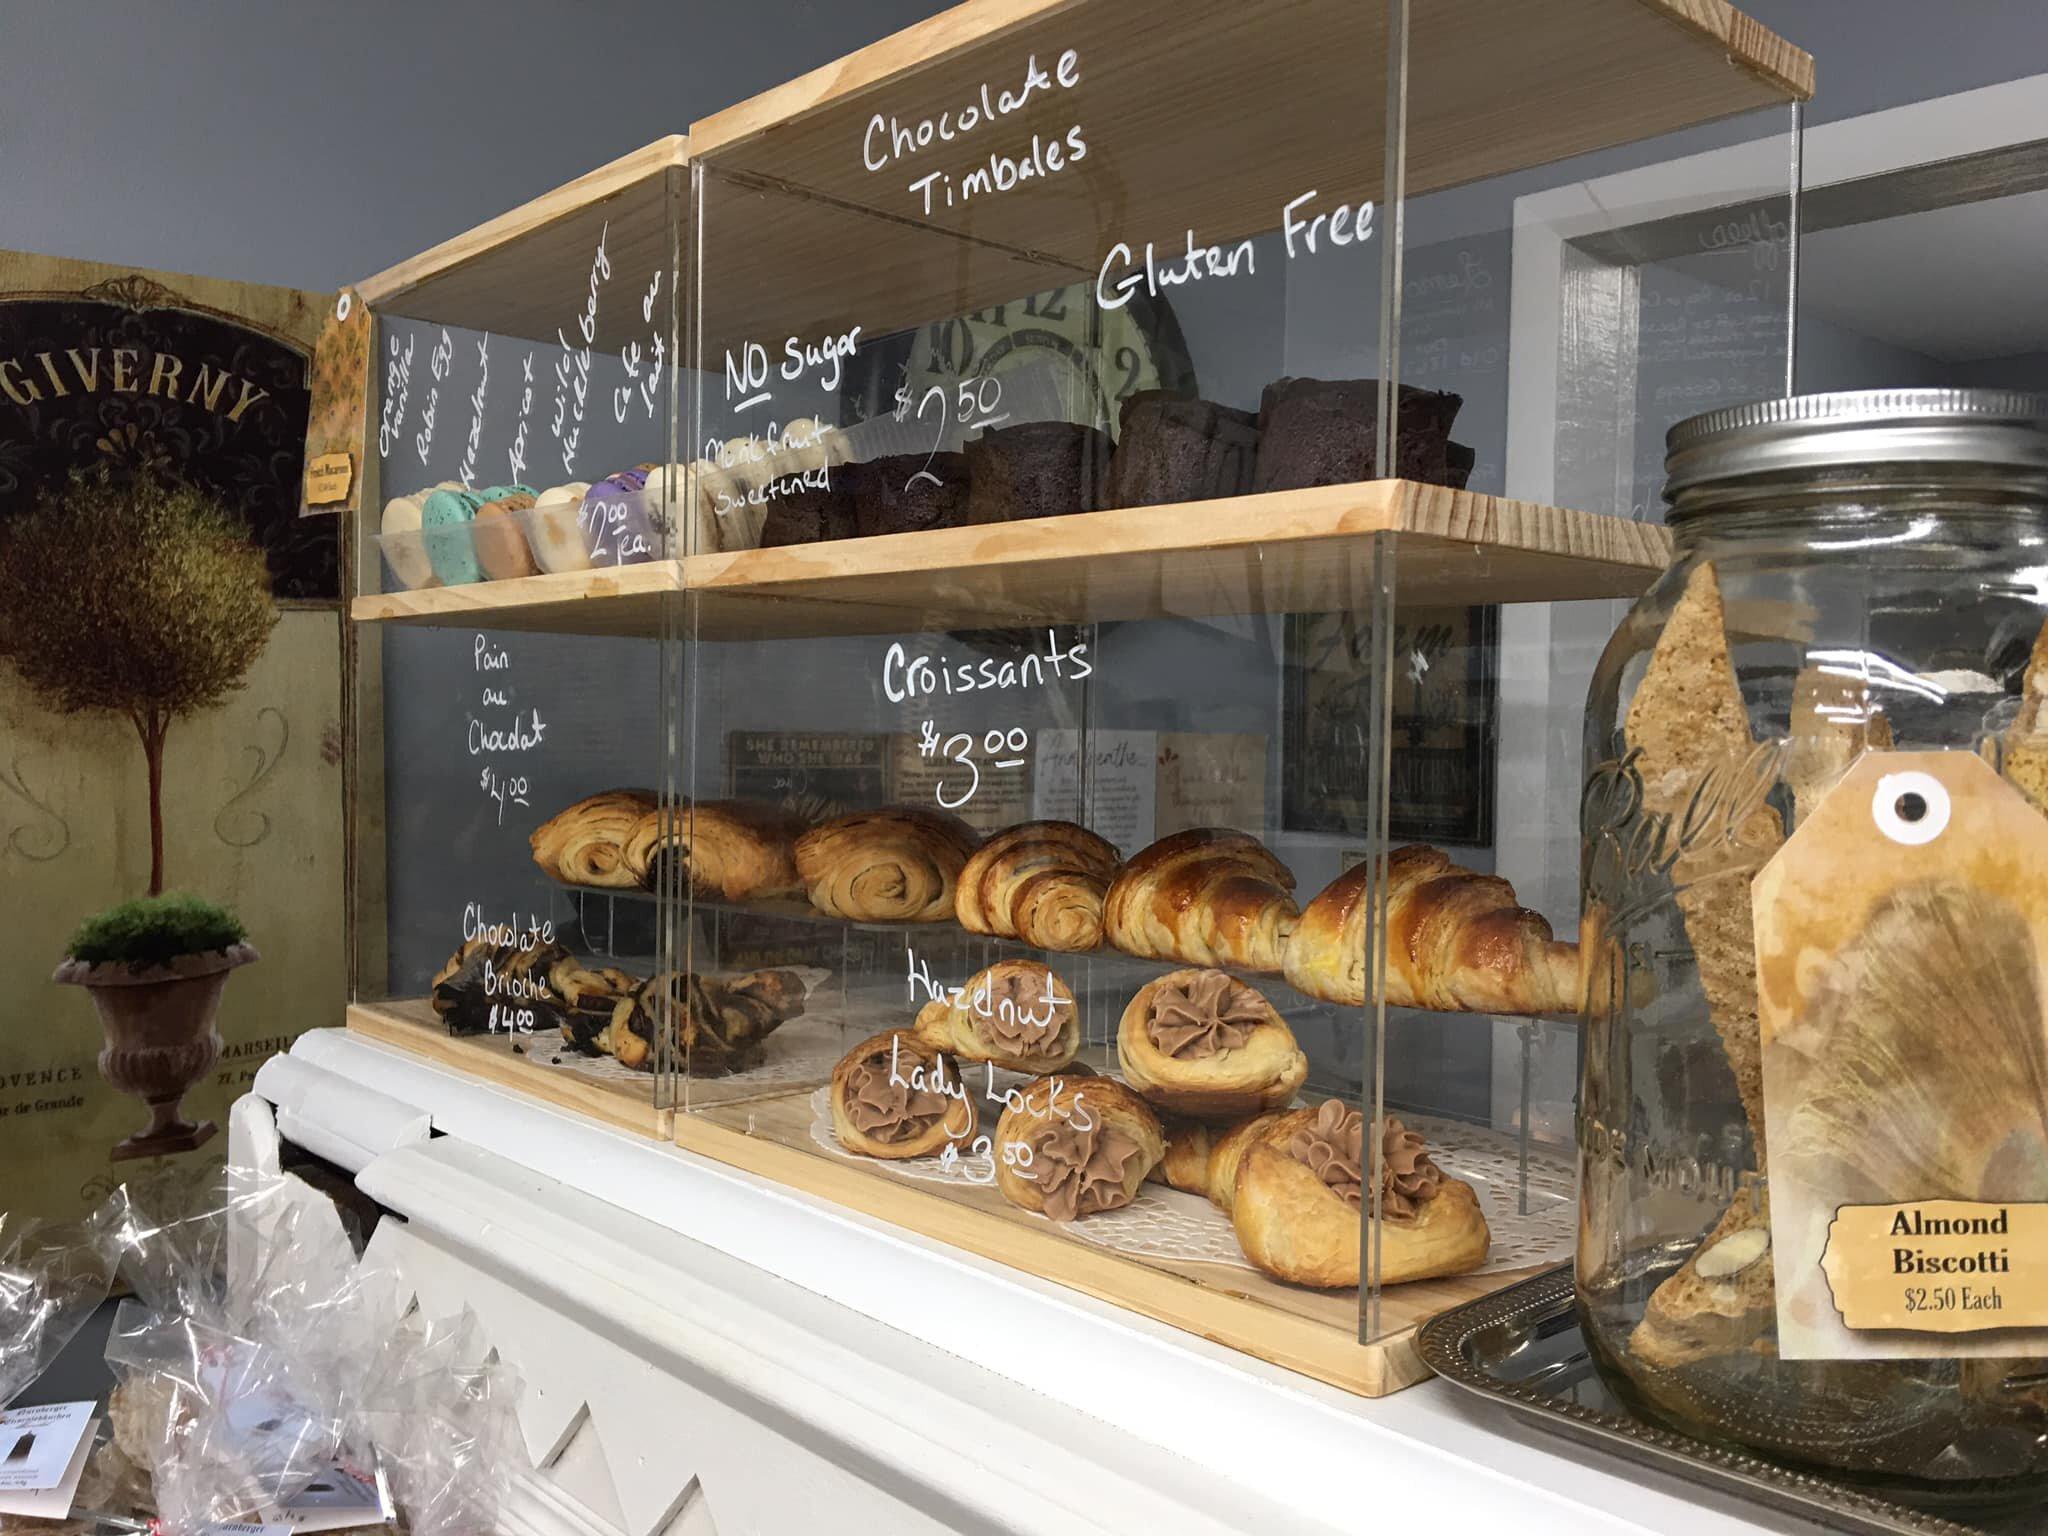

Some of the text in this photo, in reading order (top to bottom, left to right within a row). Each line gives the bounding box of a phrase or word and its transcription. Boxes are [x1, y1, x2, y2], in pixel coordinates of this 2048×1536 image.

[863, 49, 1081, 172] Chocolate
[908, 124, 1087, 215] Timbales
[1097, 190, 1374, 310] Gluten Free
[643, 270, 662, 323] au
[0, 348, 270, 424] GIVERNY
[380, 334, 401, 458] Orange
[416, 327, 453, 466] Robin Egg
[640, 331, 665, 419] lait
[726, 327, 861, 412] NO Sugar
[459, 330, 489, 491] Hazelnut
[508, 351, 533, 486] Apricot
[714, 455, 831, 516] Sweetened
[474, 633, 509, 672] Pain
[883, 629, 1093, 703] Croissants
[482, 687, 507, 706] au
[463, 901, 555, 953] Chocolate
[484, 960, 552, 1000] Brioche
[889, 1034, 1093, 1138] Lady Locks
[1890, 1209, 2009, 1236] Almond
[1892, 1248, 2010, 1274] Biscotti
[1904, 1286, 2003, 1313] $2.50 Each
